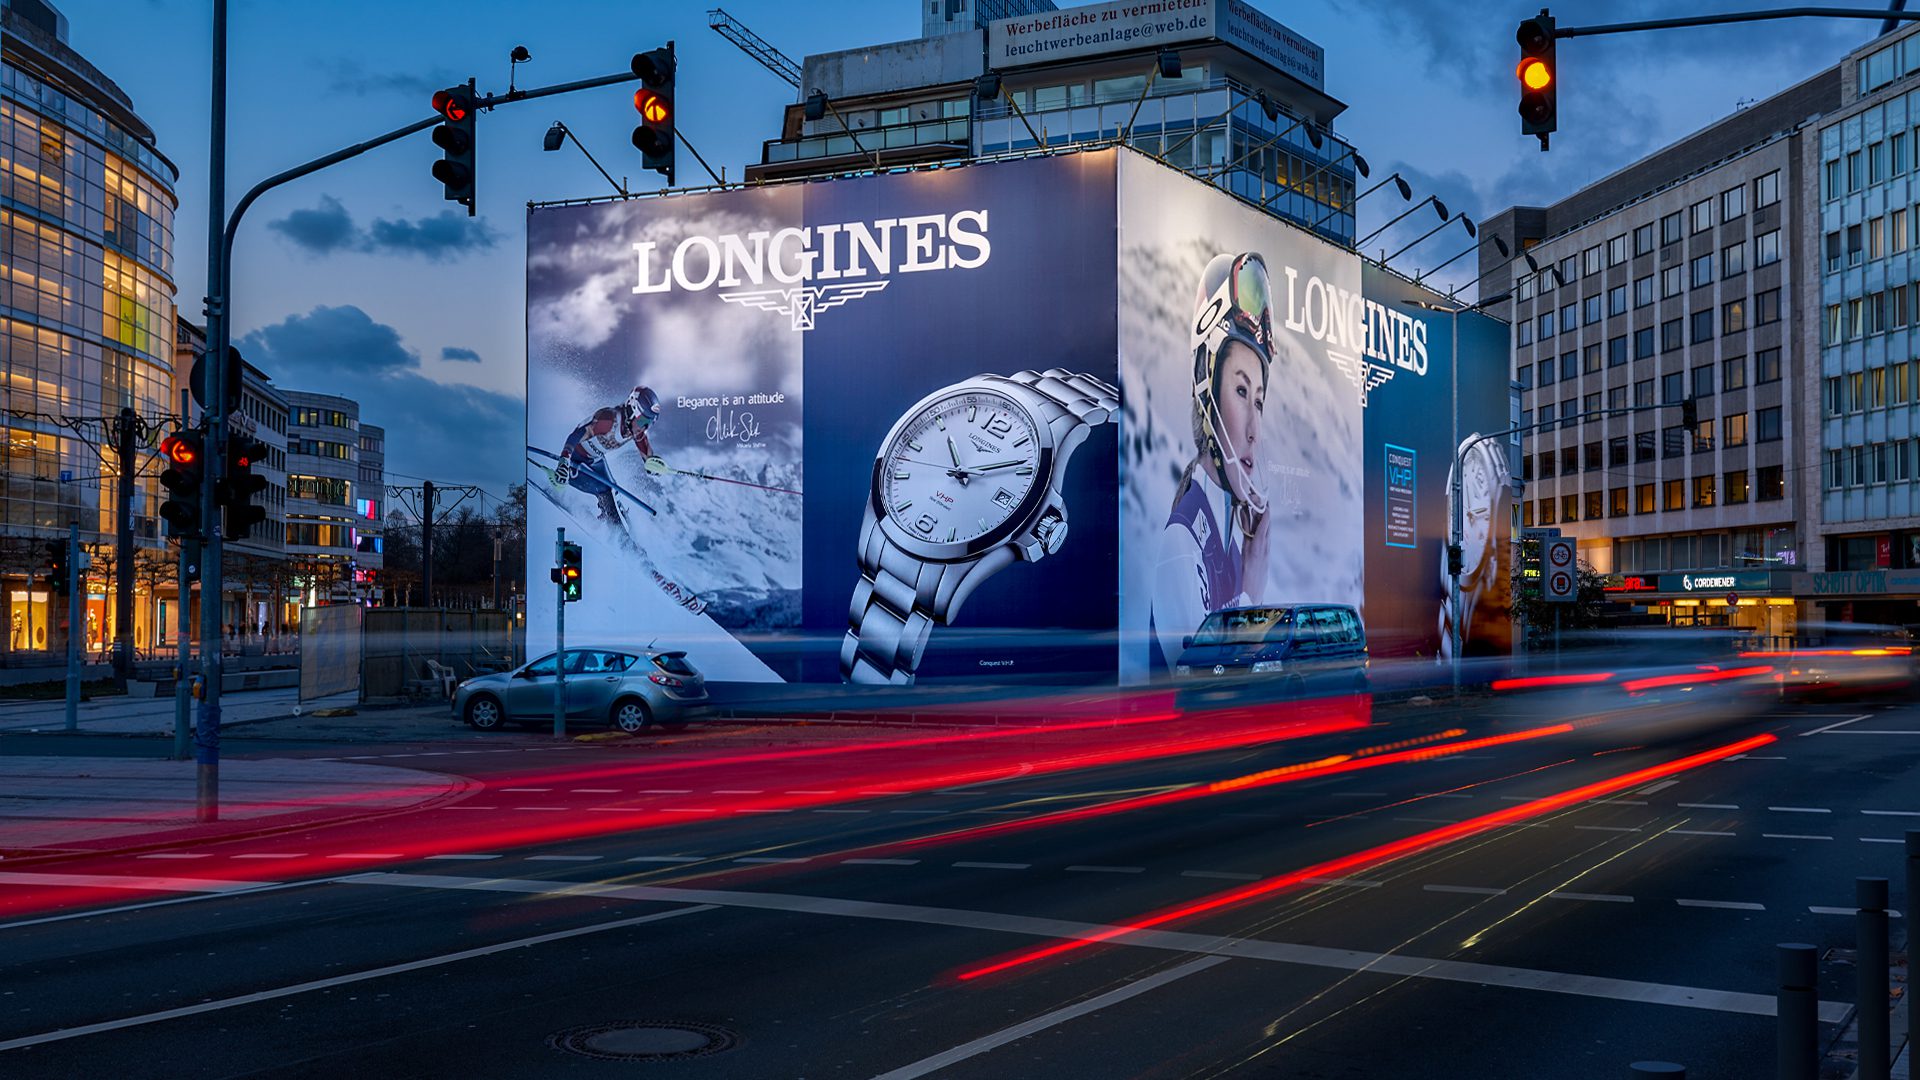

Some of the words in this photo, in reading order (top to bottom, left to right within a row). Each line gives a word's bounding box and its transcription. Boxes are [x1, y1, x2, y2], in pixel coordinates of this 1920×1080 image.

[1005, 15, 1207, 57] leuchtwerbeanlage@web.de
[1006, 11, 1097, 37] Werbefläche
[1101, 9, 1118, 20] zu
[1228, 0, 1272, 35] Werbefläche
[1273, 28, 1281, 40] zu
[1282, 34, 1319, 62] vermieten!
[1227, 20, 1319, 81] leuchtwerbeanlage@web.de
[632, 209, 991, 294] LONGINES
[1284, 265, 1428, 376] LONGINES
[677, 395, 719, 410] Elegance
[722, 395, 730, 406] is
[733, 395, 745, 405] an
[748, 392, 785, 405] attitude
[968, 432, 1002, 454] LONGINES
[981, 411, 1012, 440] 12
[1694, 576, 1735, 588] CORDEWENER
